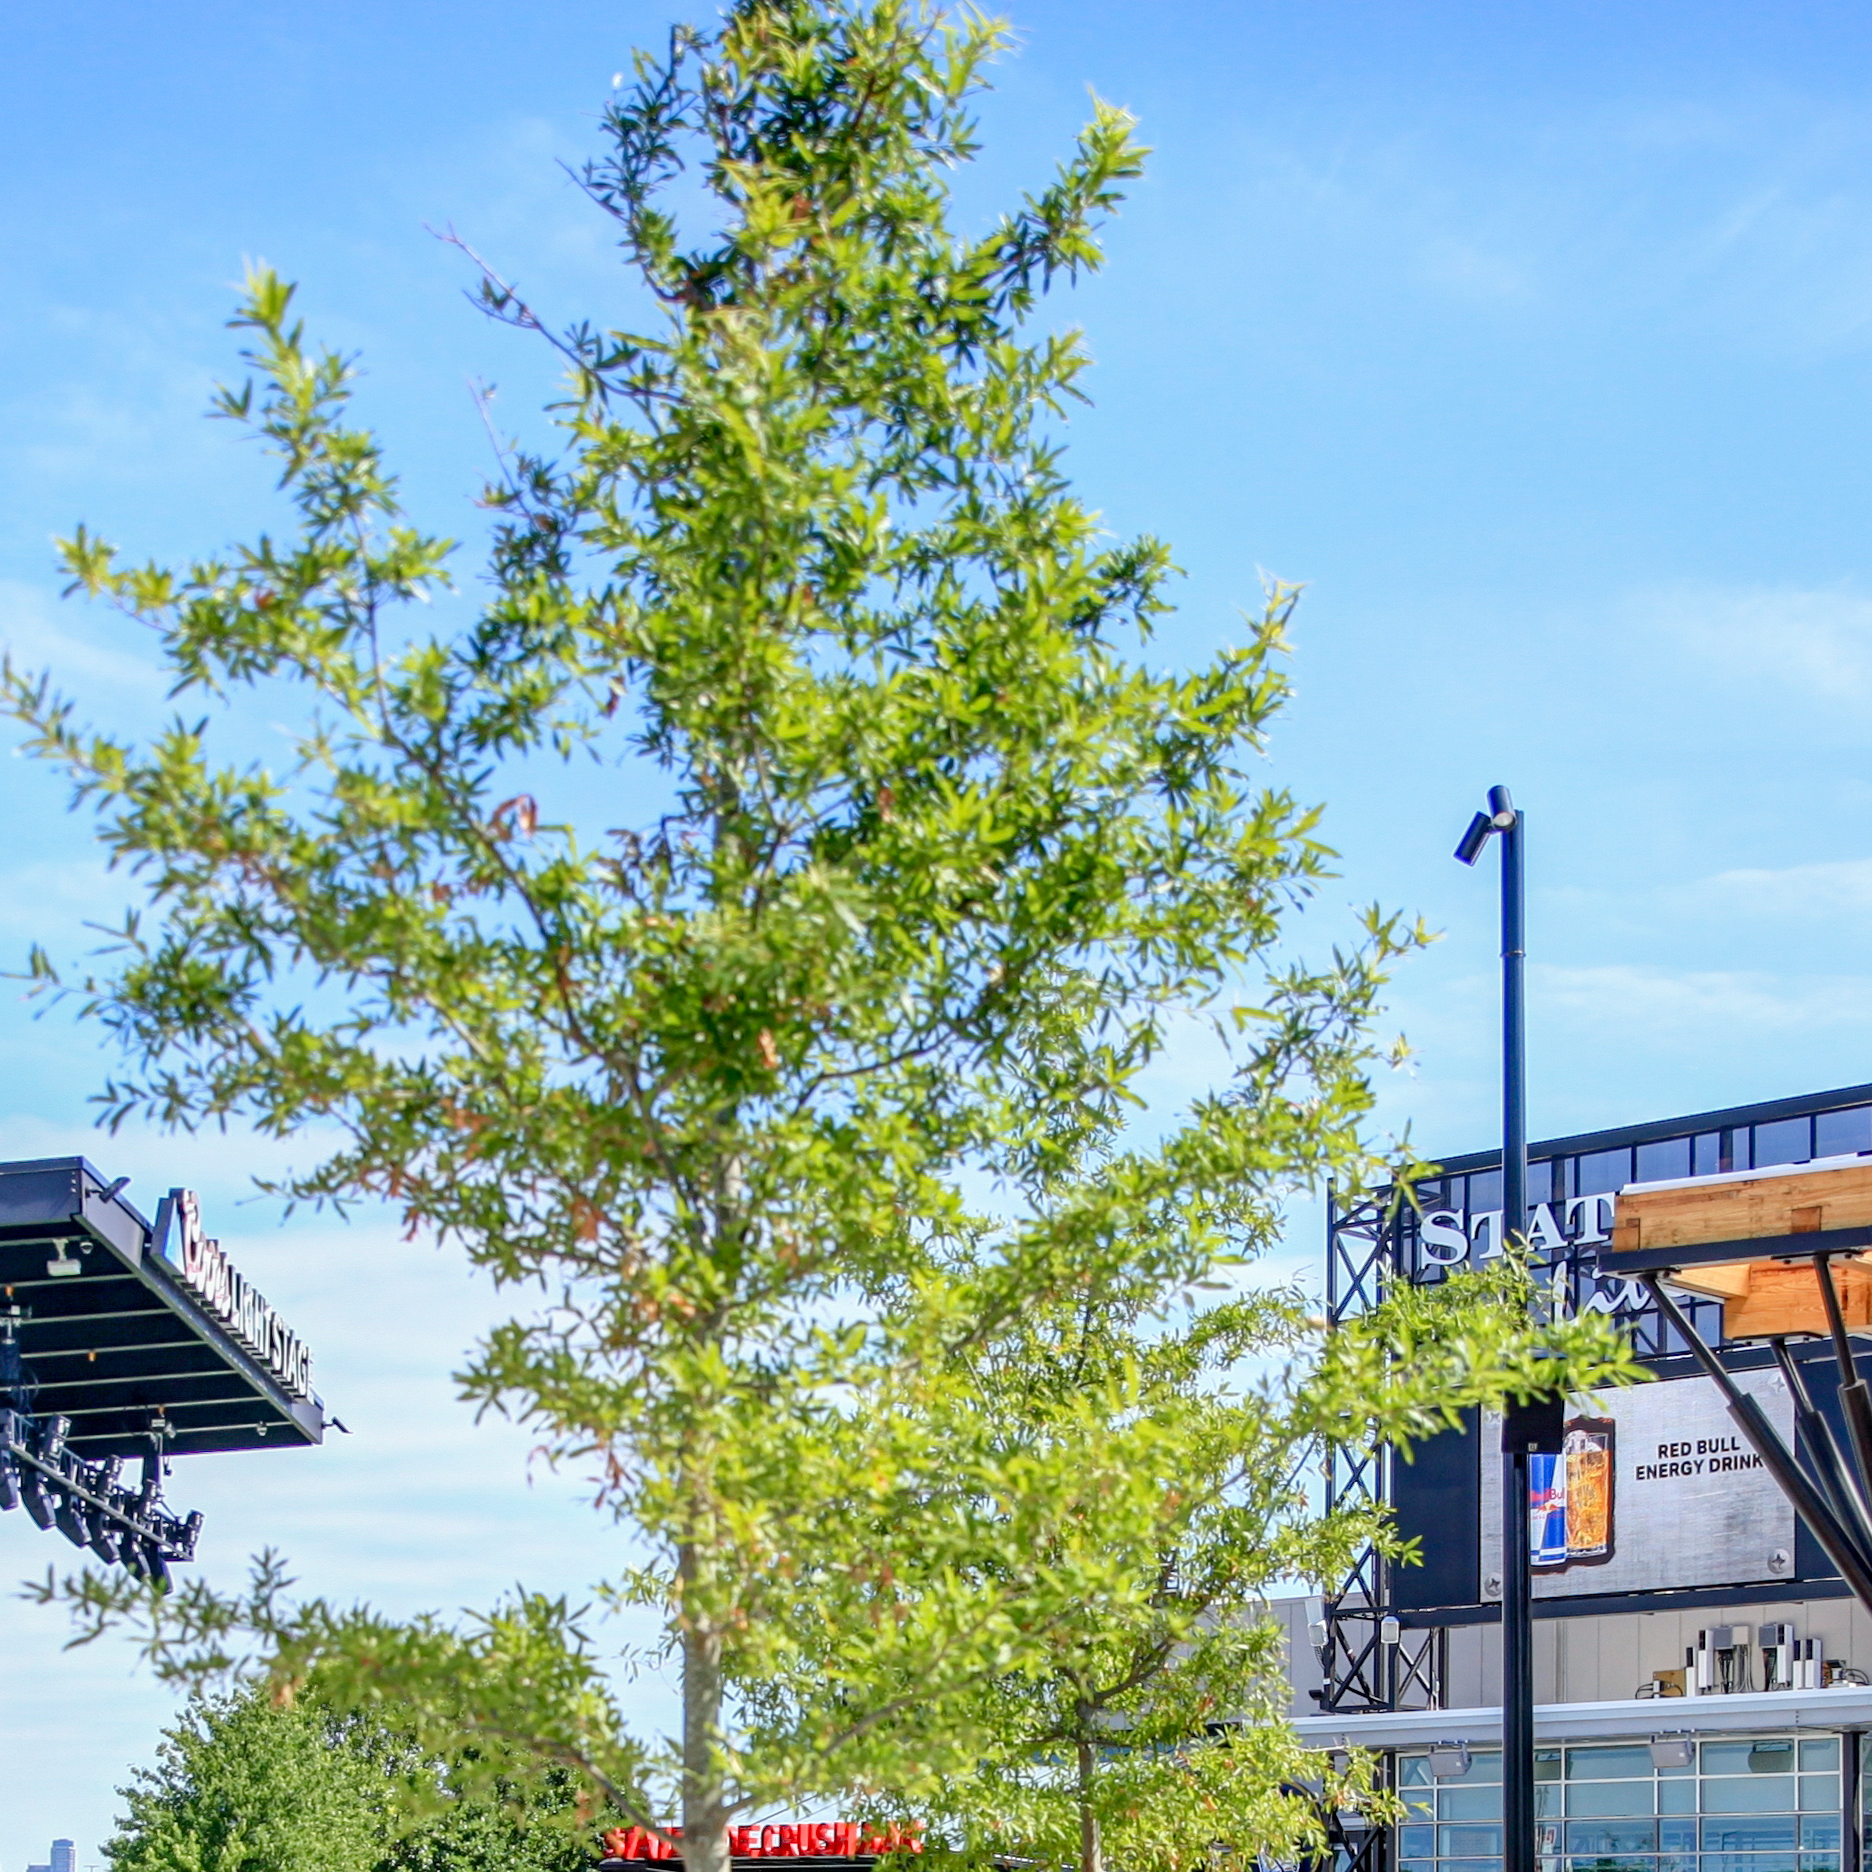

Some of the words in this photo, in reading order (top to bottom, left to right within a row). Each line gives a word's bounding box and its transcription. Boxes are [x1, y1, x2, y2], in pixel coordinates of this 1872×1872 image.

[1419, 1191, 1615, 1270] STAT
[1658, 1441, 1692, 1459] RED
[1697, 1436, 1741, 1456] BULL
[1636, 1458, 1705, 1481] ENERGY
[1709, 1453, 1764, 1473] DRINK
